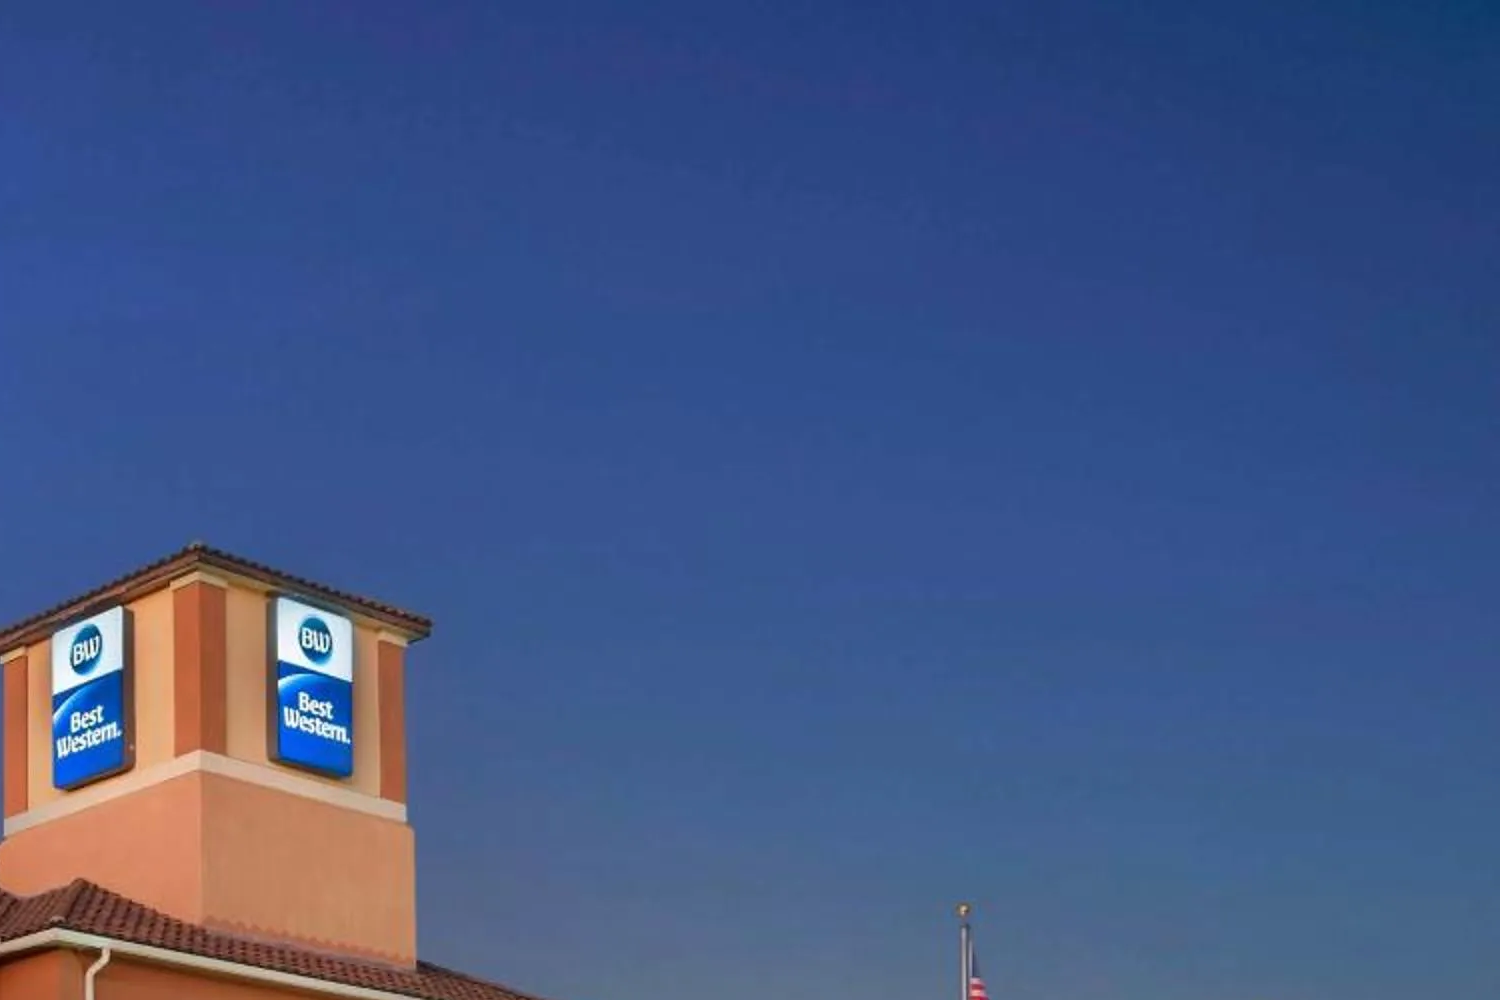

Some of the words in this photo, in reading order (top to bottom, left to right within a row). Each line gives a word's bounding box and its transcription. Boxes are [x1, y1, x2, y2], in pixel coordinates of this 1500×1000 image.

[72, 635, 100, 666] BW
[301, 628, 330, 653] BW
[70, 704, 104, 732] Best
[299, 692, 333, 719] Best
